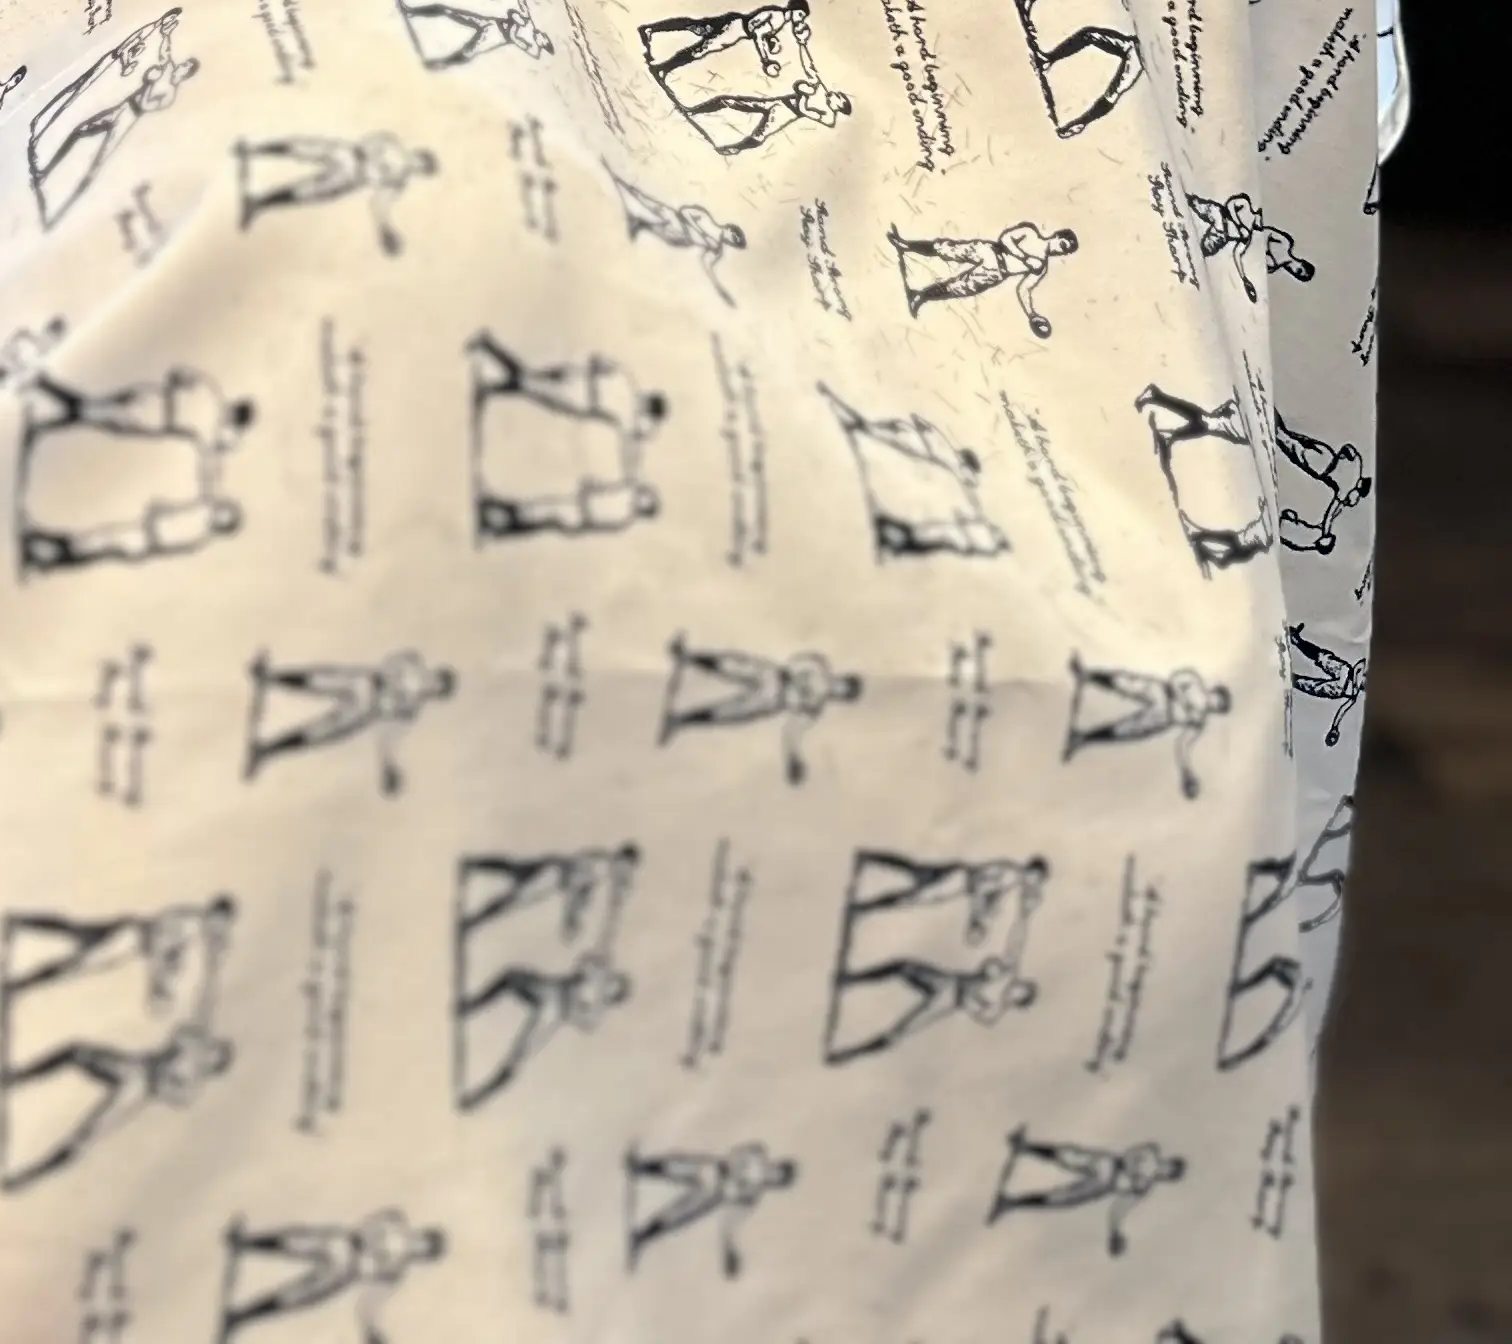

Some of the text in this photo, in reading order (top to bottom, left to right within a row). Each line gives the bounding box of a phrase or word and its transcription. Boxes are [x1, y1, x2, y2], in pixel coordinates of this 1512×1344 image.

[1167, 0, 1176, 13] a
[894, 43, 906, 58] a
[909, 15, 937, 62] hard
[1161, 15, 1189, 63] good
[1181, 23, 1204, 117] beginning
[1325, 49, 1356, 91] hard
[889, 60, 929, 106] good
[921, 63, 956, 157] beginning
[1174, 63, 1194, 129] ending
[1257, 7, 1354, 153] maketh a good ending
[912, 108, 942, 173] ending
[1276, 87, 1334, 155] beginning
[1162, 221, 1188, 284] Sharp
